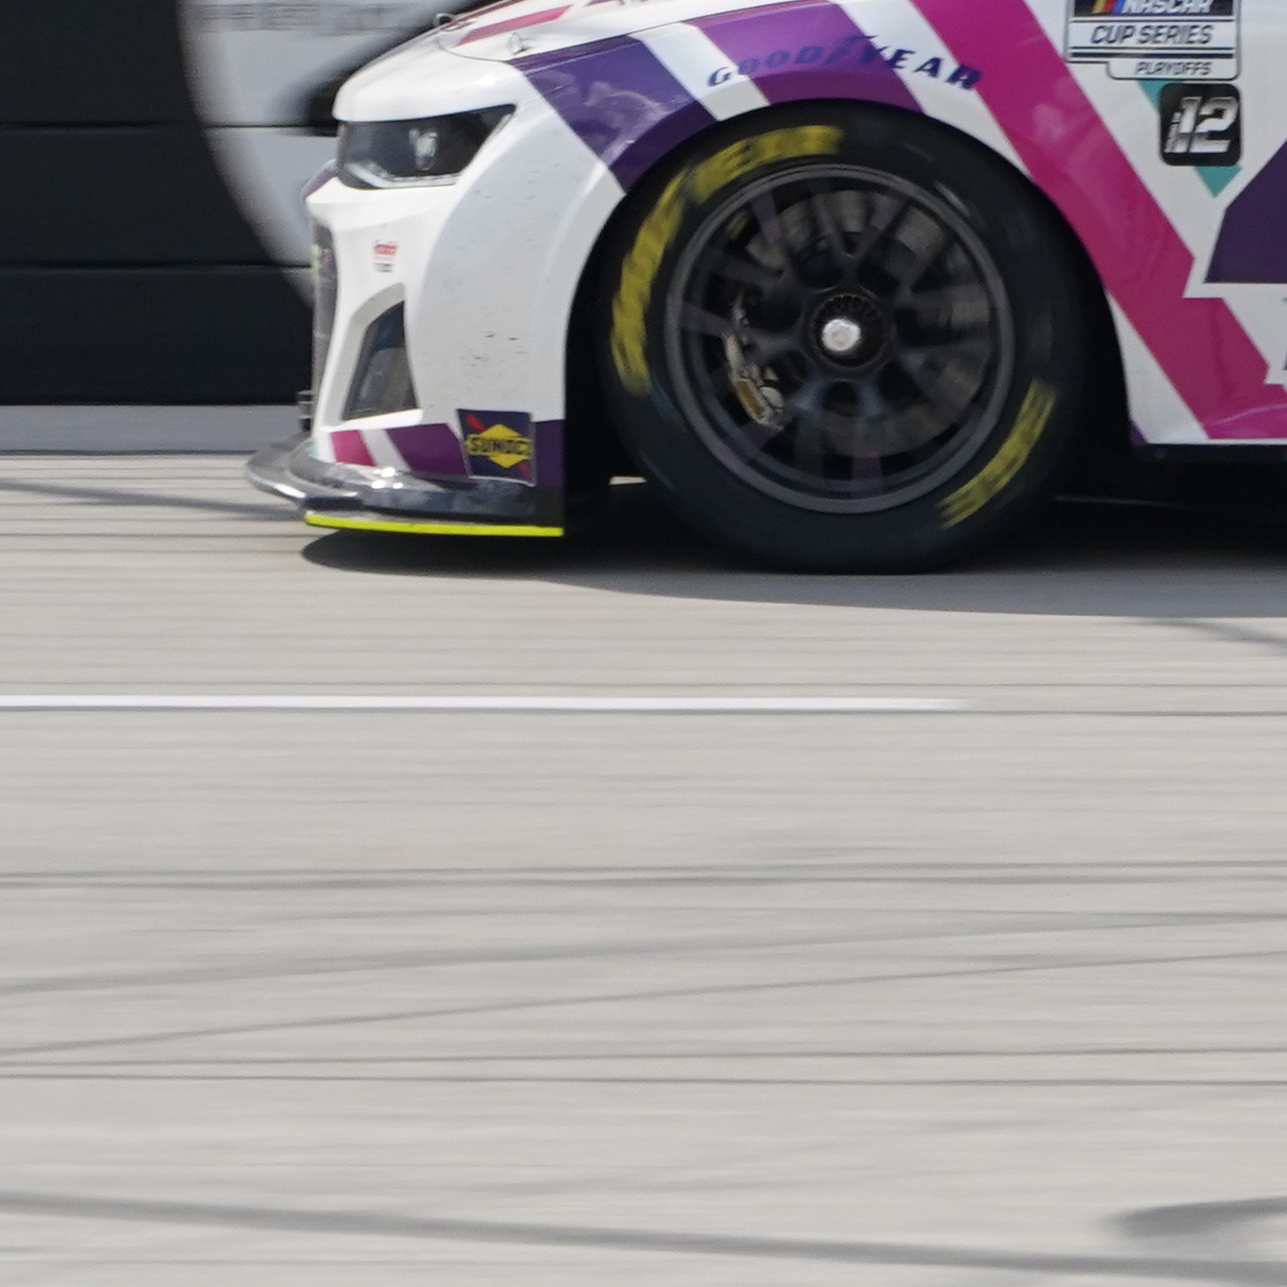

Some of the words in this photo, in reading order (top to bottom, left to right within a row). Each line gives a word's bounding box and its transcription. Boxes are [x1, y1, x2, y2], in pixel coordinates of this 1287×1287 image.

[1091, 25, 1136, 45] CUP
[1138, 25, 1214, 45] SERIES
[708, 34, 982, 90] GOODYEAR
[1135, 62, 1214, 76] PLAYOFFS
[1173, 96, 1239, 154] 12
